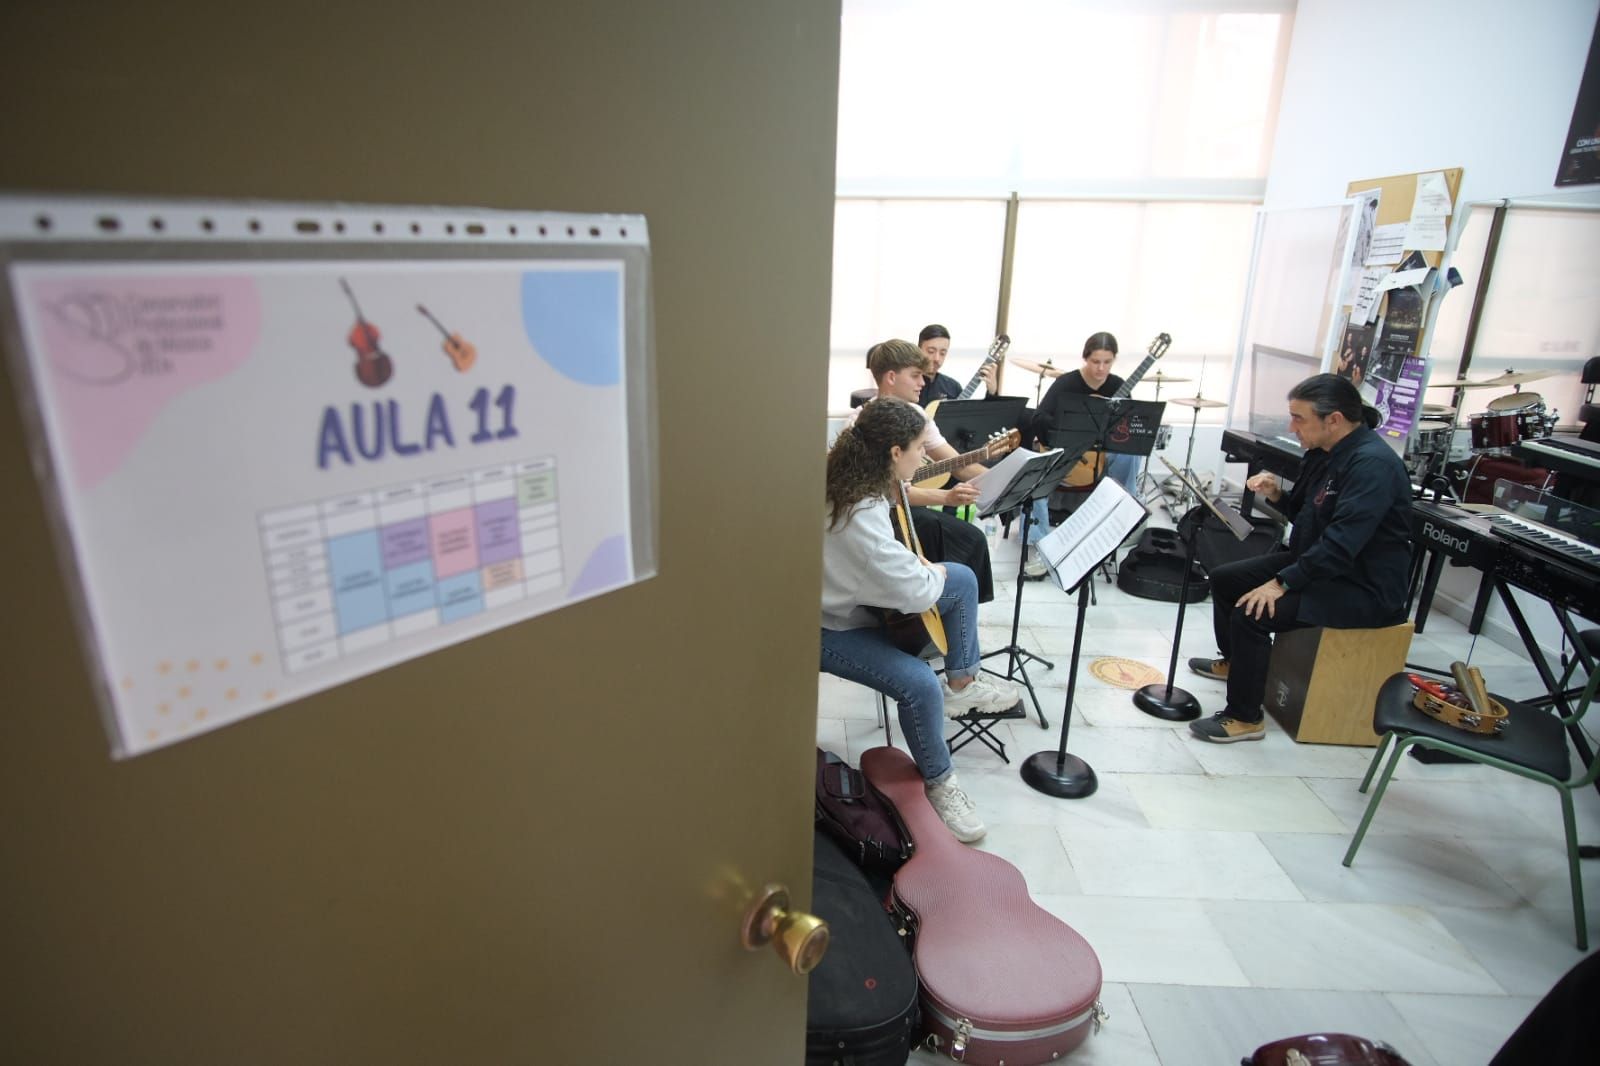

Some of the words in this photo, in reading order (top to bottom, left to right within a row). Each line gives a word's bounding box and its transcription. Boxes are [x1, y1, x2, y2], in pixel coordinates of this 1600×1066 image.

[317, 392, 455, 470] AULA
[468, 384, 519, 444] 11
[1423, 521, 1470, 553] Roland
